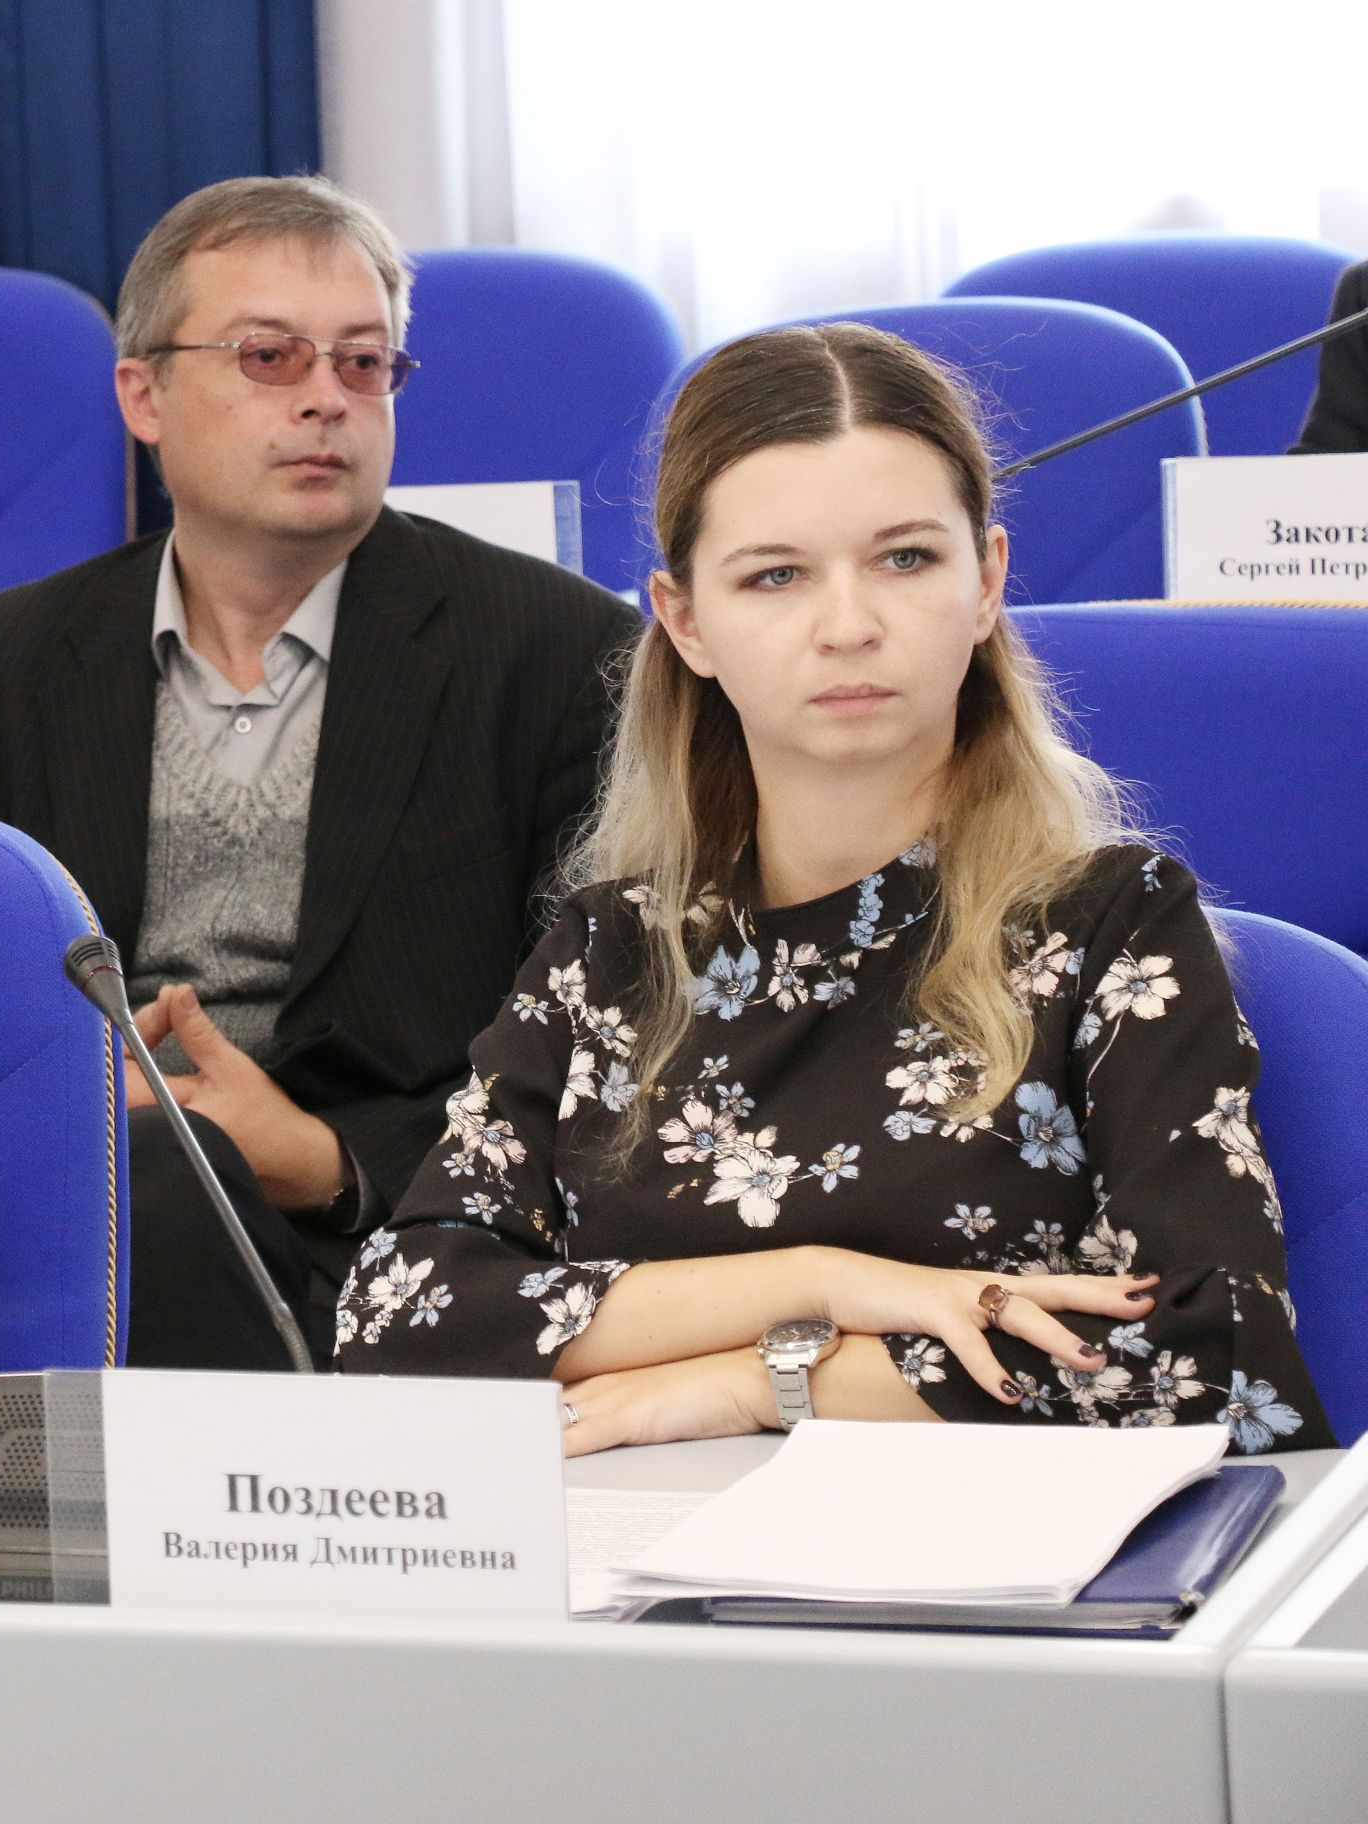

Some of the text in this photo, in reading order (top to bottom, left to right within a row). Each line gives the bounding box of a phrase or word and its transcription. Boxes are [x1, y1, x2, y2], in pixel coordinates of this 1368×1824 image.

[1219, 556, 1368, 582] Сергей Петр
[224, 1472, 450, 1521] Поздеева
[162, 1530, 518, 1575] Валерия Дмитриевна
